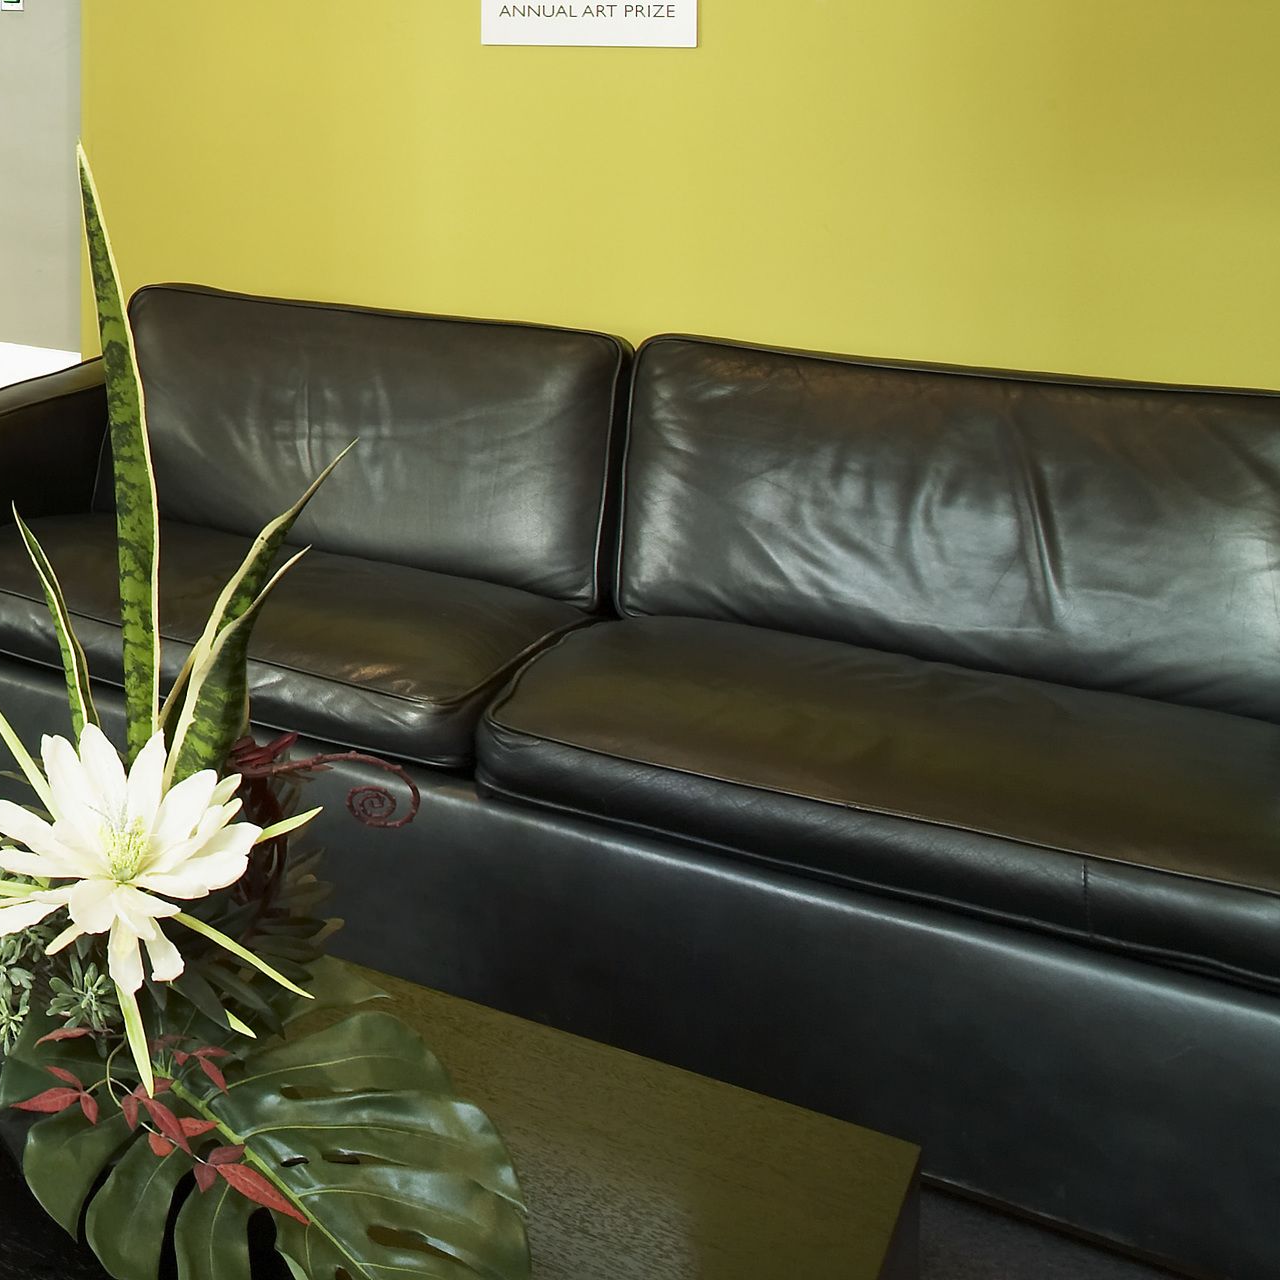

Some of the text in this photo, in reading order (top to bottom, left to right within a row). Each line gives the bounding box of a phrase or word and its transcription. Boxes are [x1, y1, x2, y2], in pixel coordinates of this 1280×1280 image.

[499, 4, 676, 19] ANNUAL ART PRIZE
